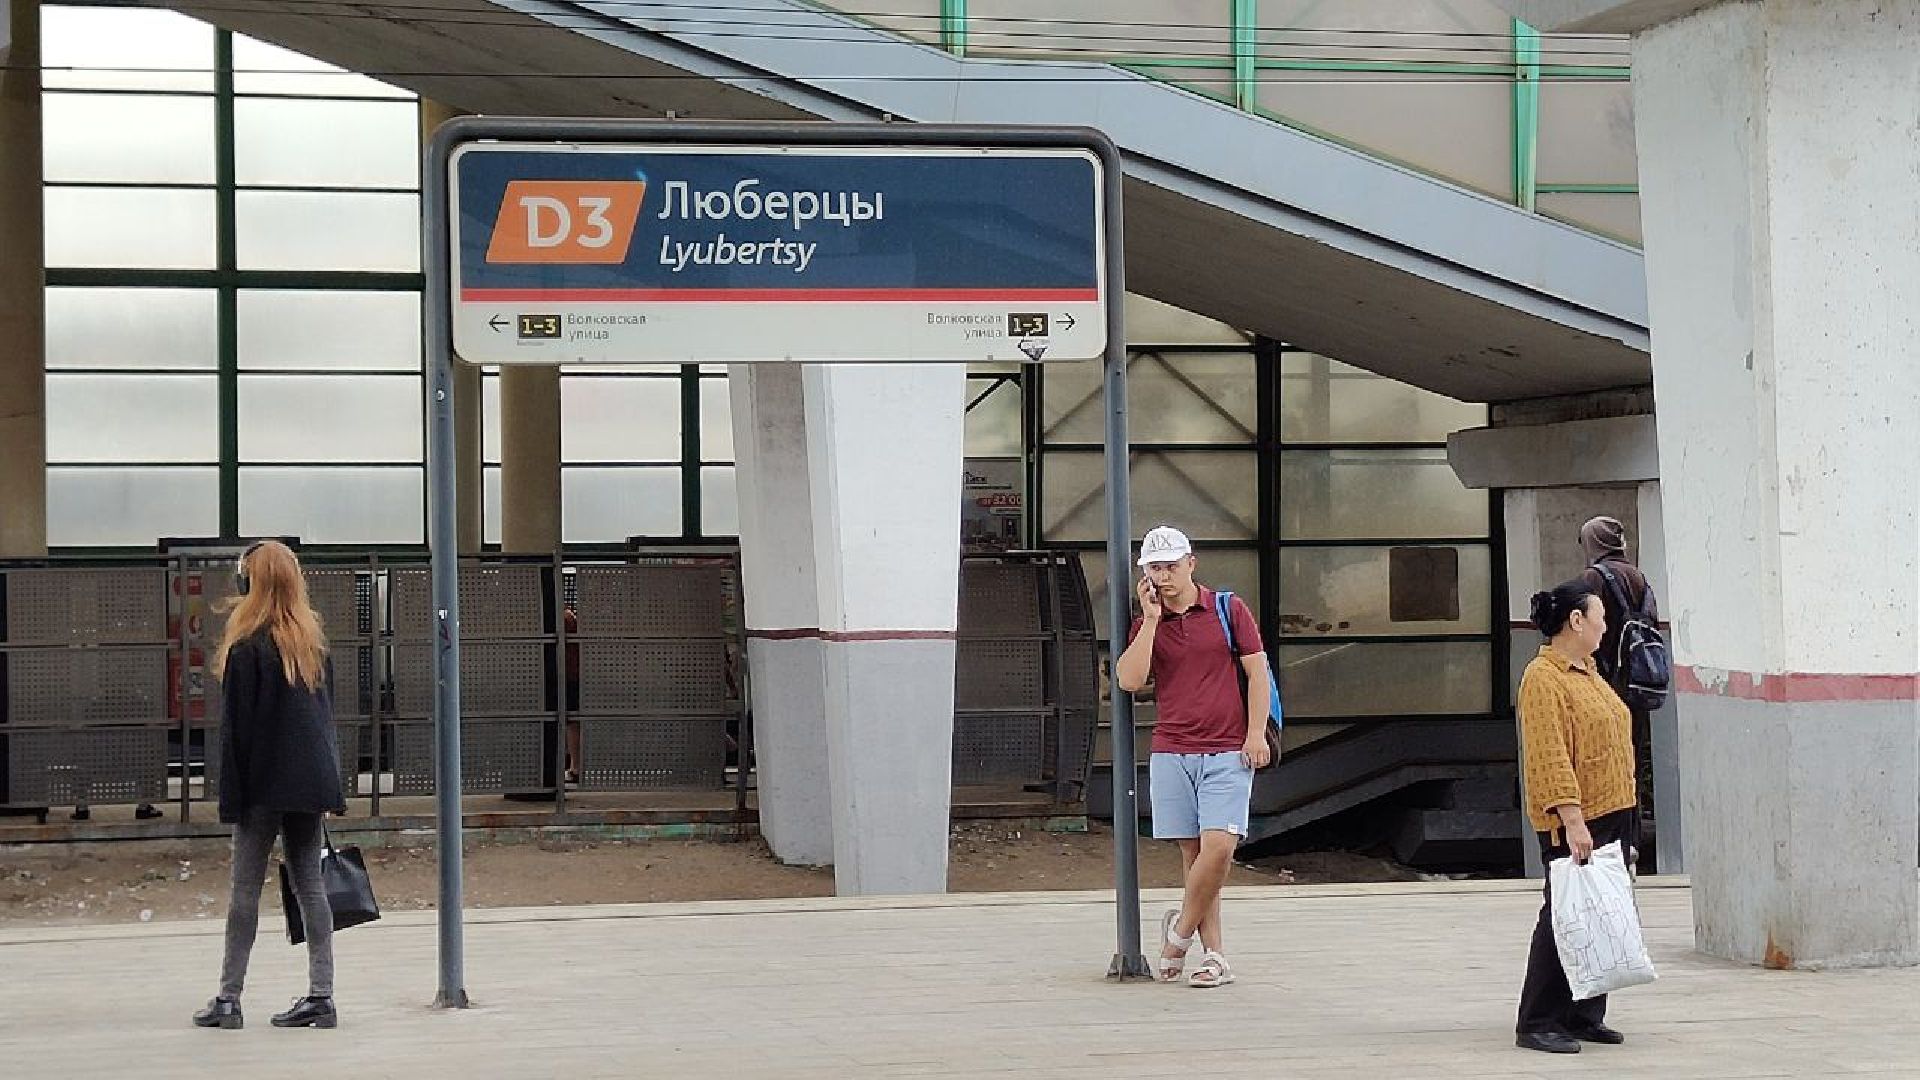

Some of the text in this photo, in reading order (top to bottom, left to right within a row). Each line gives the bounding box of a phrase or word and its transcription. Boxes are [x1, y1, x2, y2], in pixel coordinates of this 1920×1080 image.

[658, 178, 884, 230] Люберцы
[519, 196, 613, 249] D3
[659, 233, 817, 272] Lyubertsy
[566, 312, 647, 325] Волковская
[926, 312, 1003, 325] Волковская
[568, 329, 610, 342] улица
[963, 327, 1003, 341] улица
